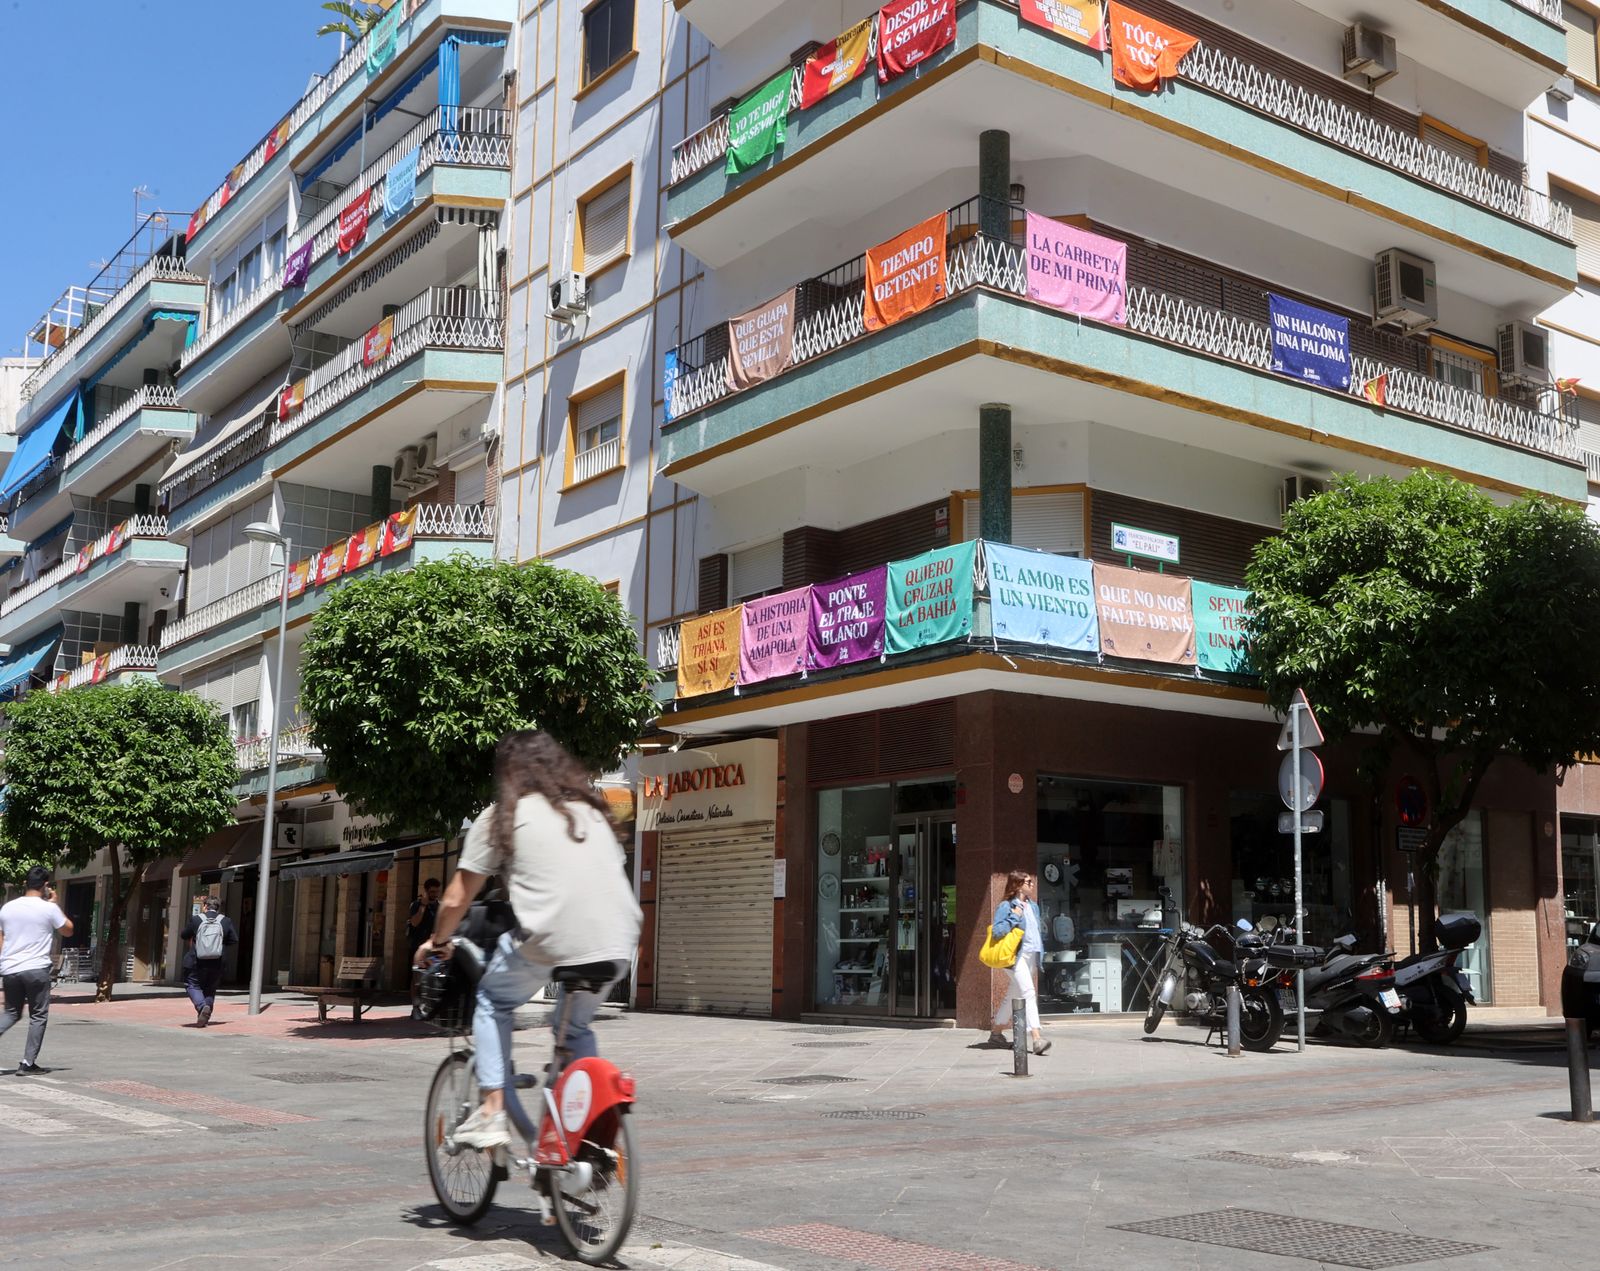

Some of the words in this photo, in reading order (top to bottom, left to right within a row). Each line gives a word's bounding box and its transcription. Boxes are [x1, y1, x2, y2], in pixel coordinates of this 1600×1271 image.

[883, 38, 892, 54] A
[894, 1, 948, 48] SEVILLA
[885, 0, 929, 35] DESDE
[735, 117, 747, 133] YO
[749, 107, 760, 125] TE
[762, 90, 784, 116] DIGO
[881, 236, 933, 277] TIEMPO
[1033, 234, 1051, 253] LA
[1055, 241, 1120, 275] CARRETA
[874, 256, 939, 302] DETENTE
[1031, 254, 1050, 275] DE
[1054, 262, 1072, 281] MI
[1077, 268, 1121, 295] PRIMA
[736, 319, 755, 339] QUE
[757, 303, 788, 329] GUAPA
[739, 335, 758, 354] QUE
[760, 318, 784, 345] ESTÁ
[1273, 312, 1289, 329] UN
[1291, 318, 1336, 342] HALCÓN
[1336, 331, 1345, 345] Y
[742, 340, 779, 369] SEVILLA
[1276, 331, 1299, 351] UNA
[1301, 338, 1345, 363] PALOMA
[906, 558, 953, 586] QUIERO
[992, 563, 1013, 582] EL
[1018, 568, 1065, 592] AMOR
[1069, 577, 1090, 596] ES
[828, 583, 867, 608] PONTE
[904, 577, 953, 607] CRUZAR
[1000, 588, 1024, 608] UN
[1027, 593, 1088, 619] VIENTO
[1100, 584, 1131, 604] QUE
[1134, 589, 1154, 608] NO
[1157, 594, 1186, 612] NOS
[747, 612, 758, 626] LA
[760, 598, 806, 622] HISTORIA
[819, 613, 835, 627] EL
[837, 600, 874, 623] TRAJE
[899, 611, 914, 627] LA
[917, 595, 956, 623] BAHÍA
[1102, 605, 1147, 627] FALTE
[1148, 612, 1169, 631] DE
[1171, 615, 1192, 632] NÁ
[697, 621, 711, 641] ASÍ
[714, 620, 725, 636] ES
[757, 625, 770, 641] DE
[772, 620, 792, 636] UNA
[822, 622, 868, 646] BLANCO
[710, 653, 719, 672] SÍ
[750, 638, 796, 661] AMAPOLA
[664, 763, 746, 800] JABOTECA
[705, 803, 733, 822] Naturales
